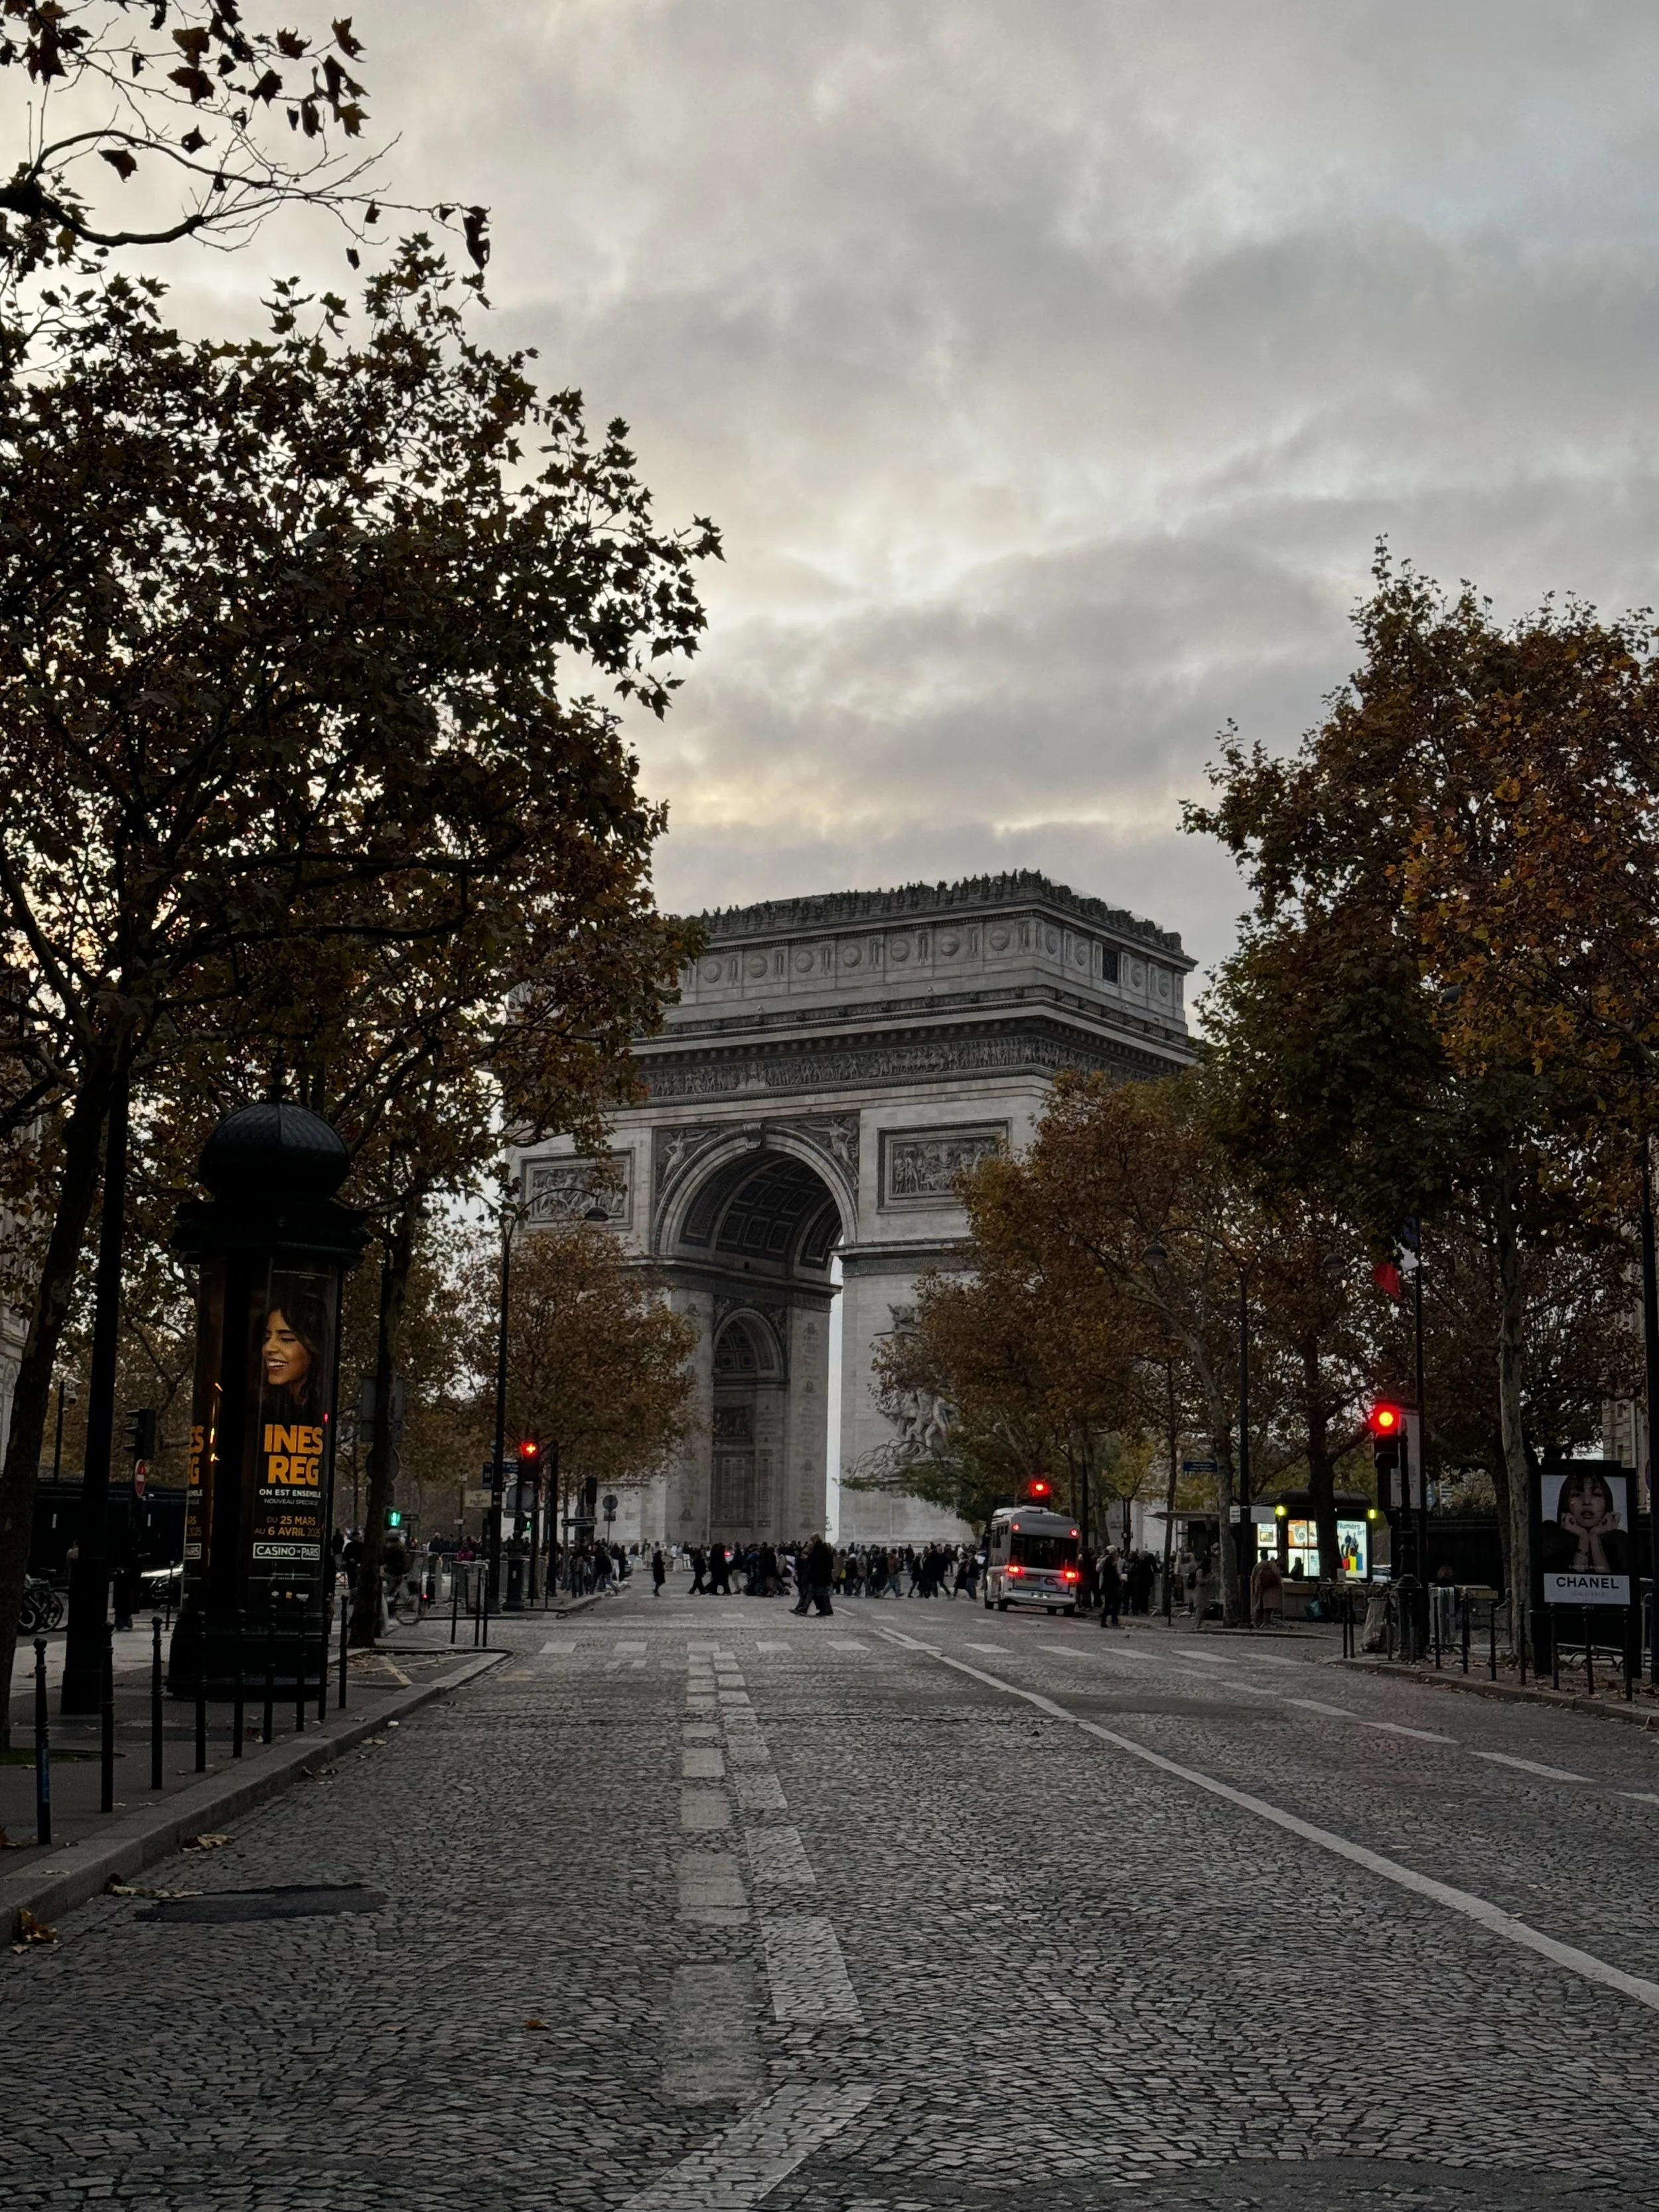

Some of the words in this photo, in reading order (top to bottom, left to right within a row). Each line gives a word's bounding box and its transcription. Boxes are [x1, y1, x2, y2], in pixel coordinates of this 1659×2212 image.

[264, 1424, 323, 1455] INES
[267, 1455, 319, 1485] REG
[279, 1516, 293, 1524] 25
[295, 1516, 316, 1526] MARS
[267, 1526, 275, 1536] 6
[277, 1526, 305, 1536] AVRIL
[256, 1546, 296, 1556] CASINO
[302, 1547, 319, 1557] PARIS
[1556, 1577, 1619, 1589] CHANEL
